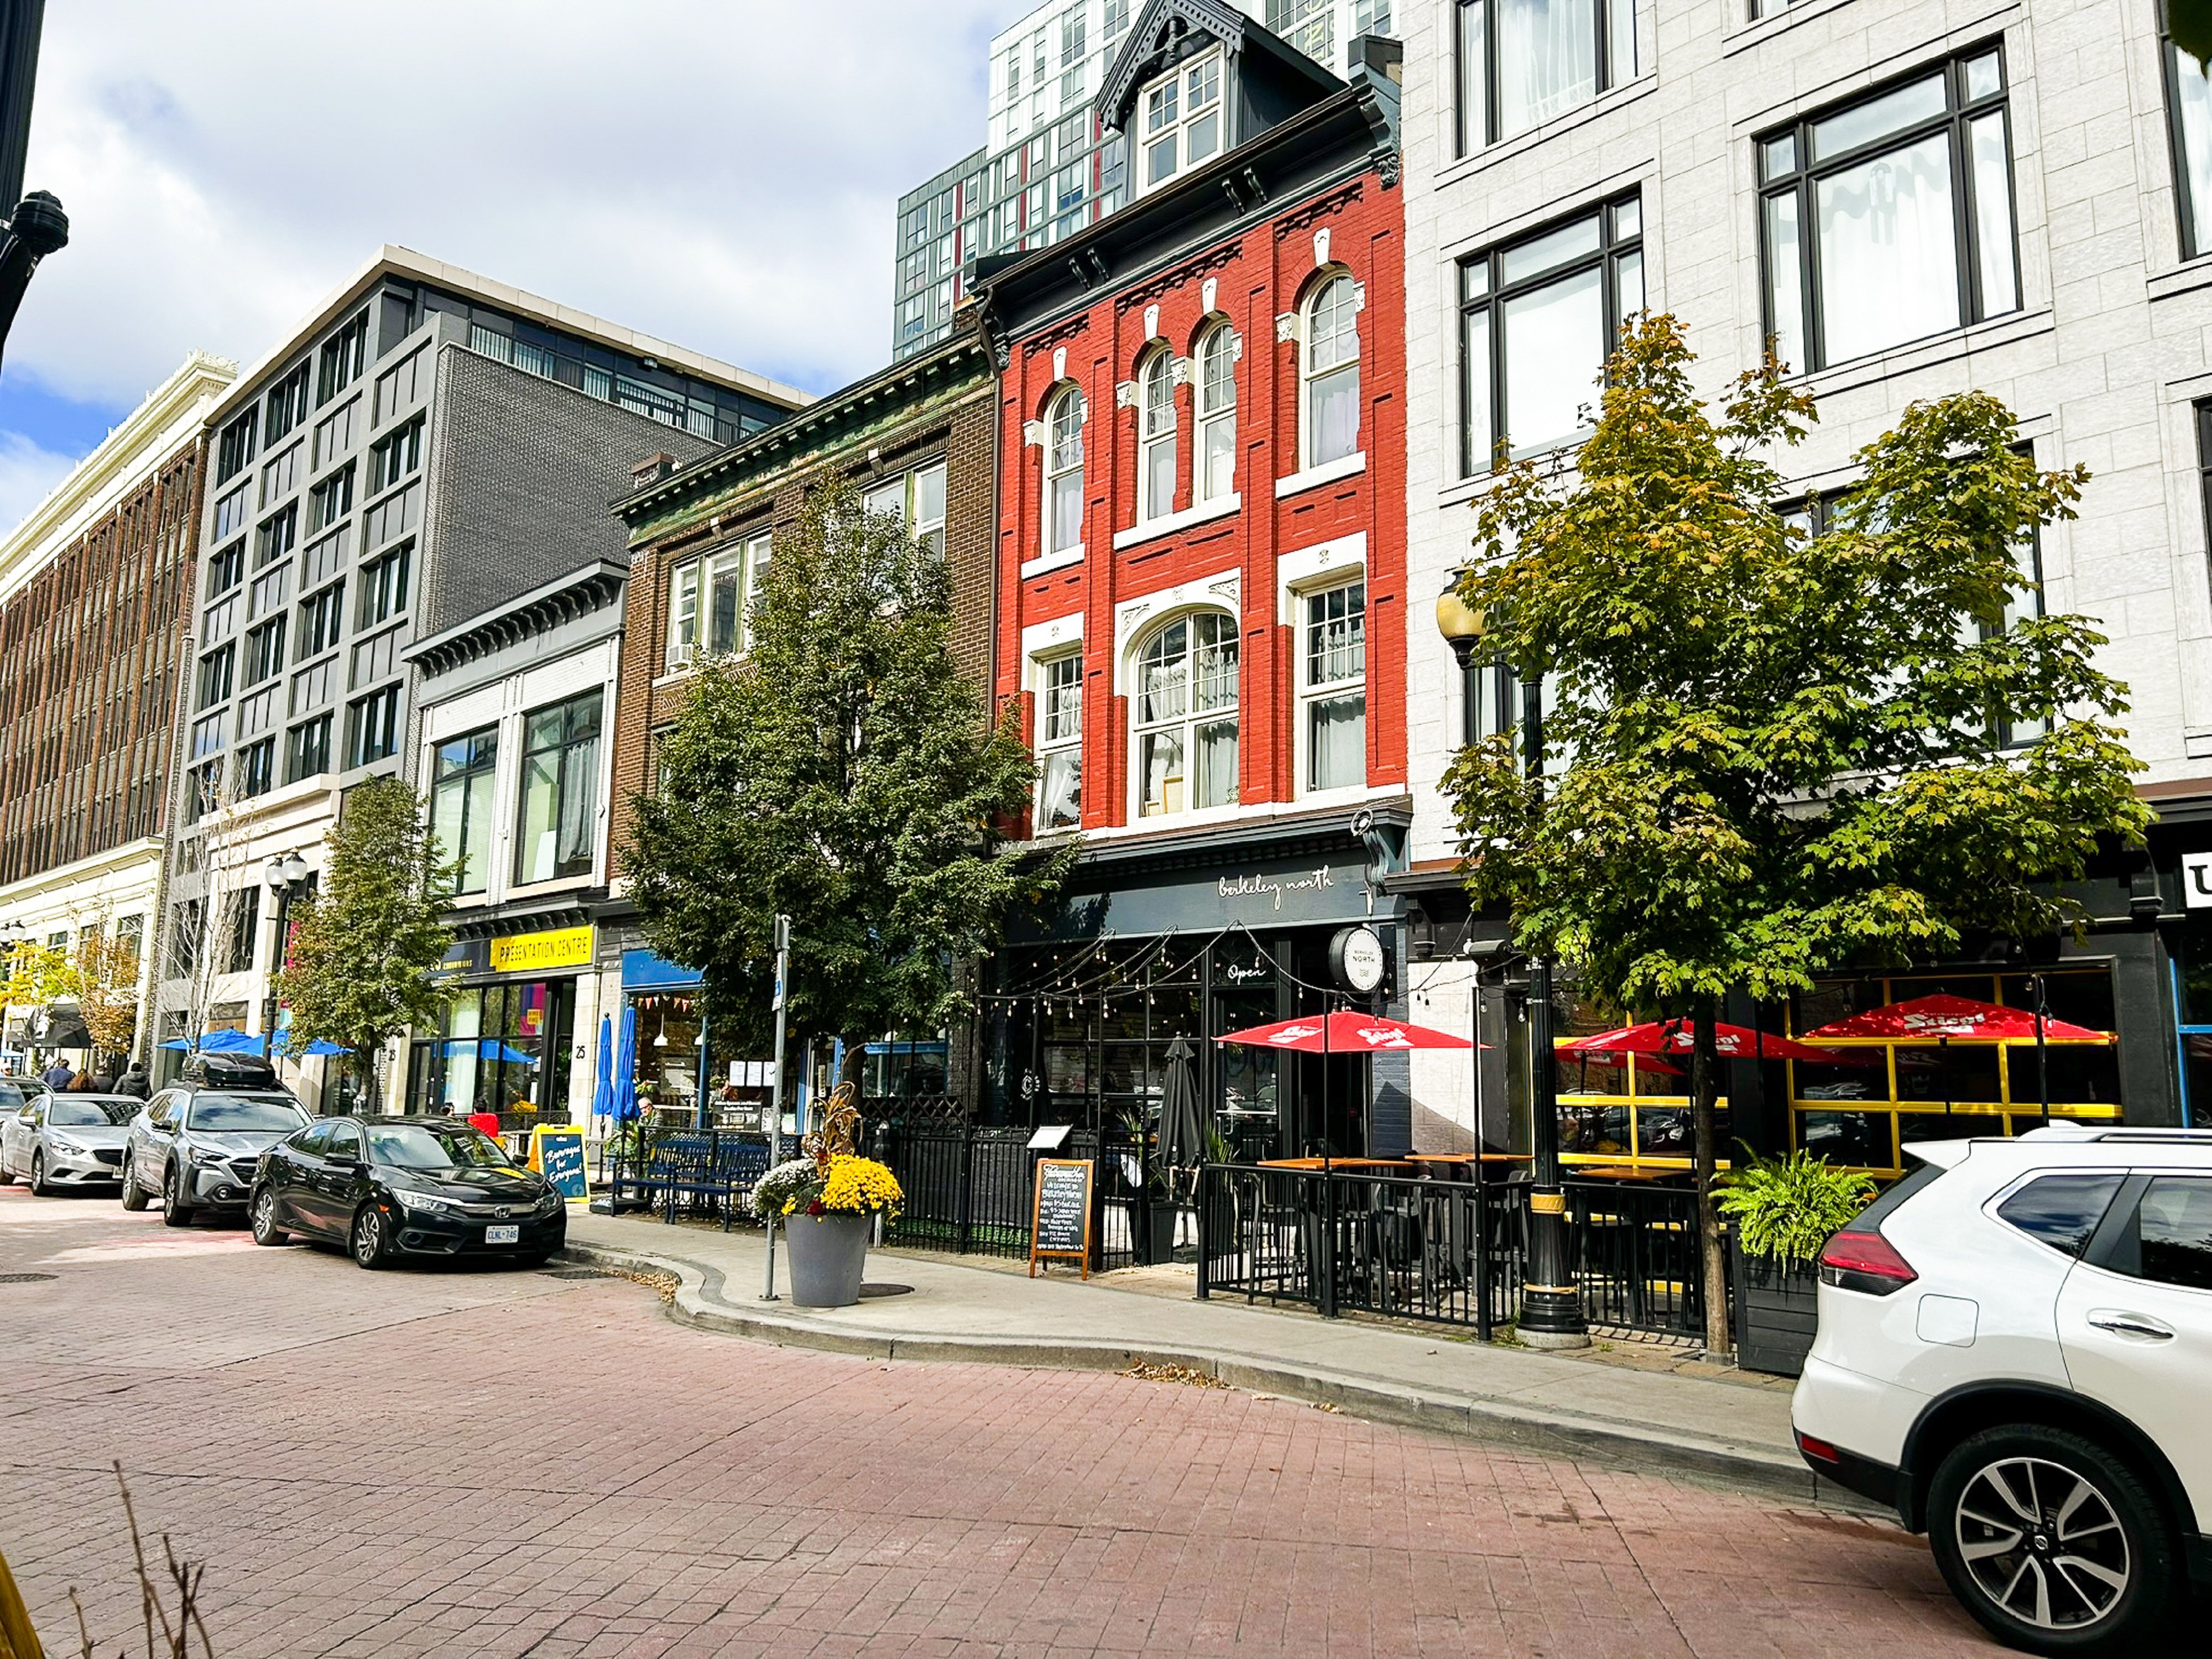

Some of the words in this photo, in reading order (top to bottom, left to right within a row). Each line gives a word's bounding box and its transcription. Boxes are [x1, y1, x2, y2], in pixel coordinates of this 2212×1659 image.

[1218, 873, 1281, 911] berkeley
[1286, 864, 1334, 891] north
[500, 941, 555, 963] PRESENTATION
[557, 937, 588, 957] CENTRE
[1353, 956, 1375, 964] NORTH
[1228, 964, 1266, 985] Open
[576, 1045, 585, 1059] 25
